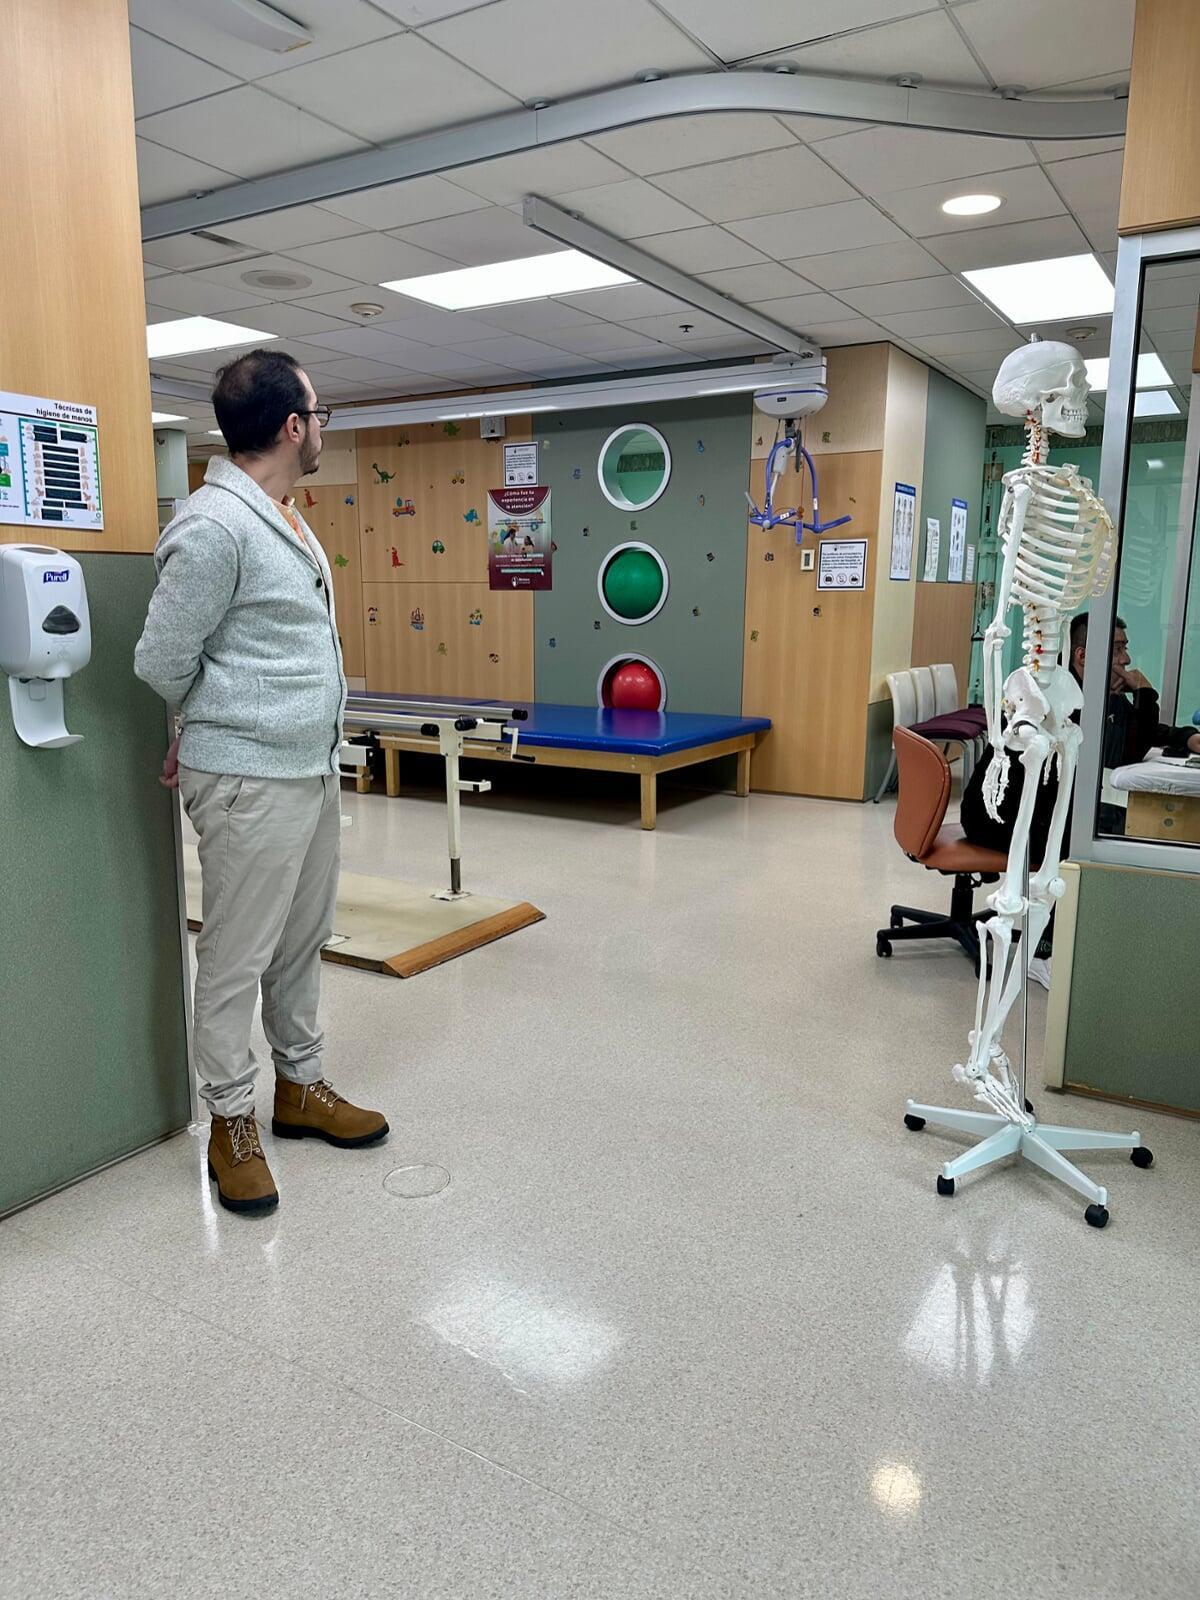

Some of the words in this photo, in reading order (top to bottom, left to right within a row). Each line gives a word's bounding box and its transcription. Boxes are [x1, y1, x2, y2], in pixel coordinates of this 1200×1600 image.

[54, 402, 83, 414] Técnicas
[36, 408, 61, 418] higiene
[71, 415, 93, 423] manos
